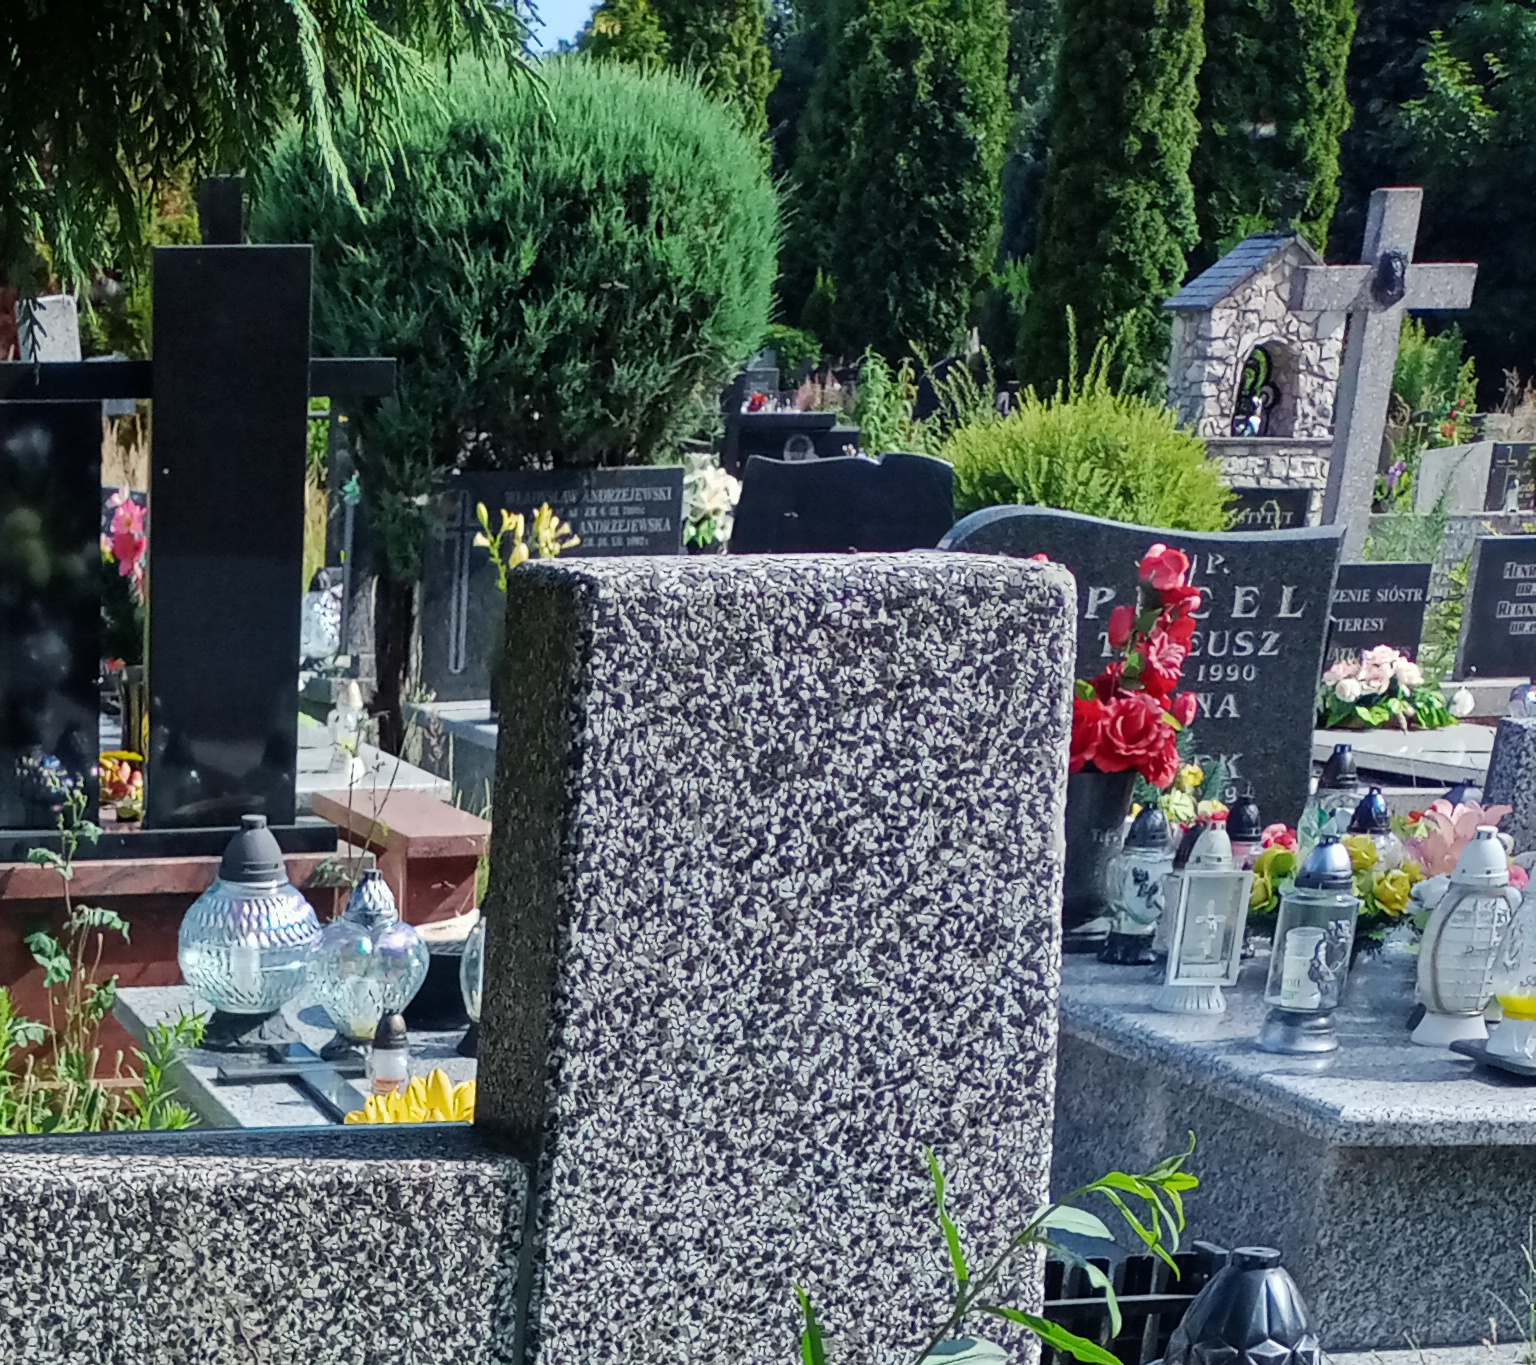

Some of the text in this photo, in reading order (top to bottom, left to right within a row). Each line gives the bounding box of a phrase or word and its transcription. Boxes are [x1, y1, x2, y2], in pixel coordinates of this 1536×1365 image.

[1376, 584, 1424, 602] SIÓSTR
[1337, 617, 1388, 632] TERESY
[1197, 664, 1257, 682] 1990
